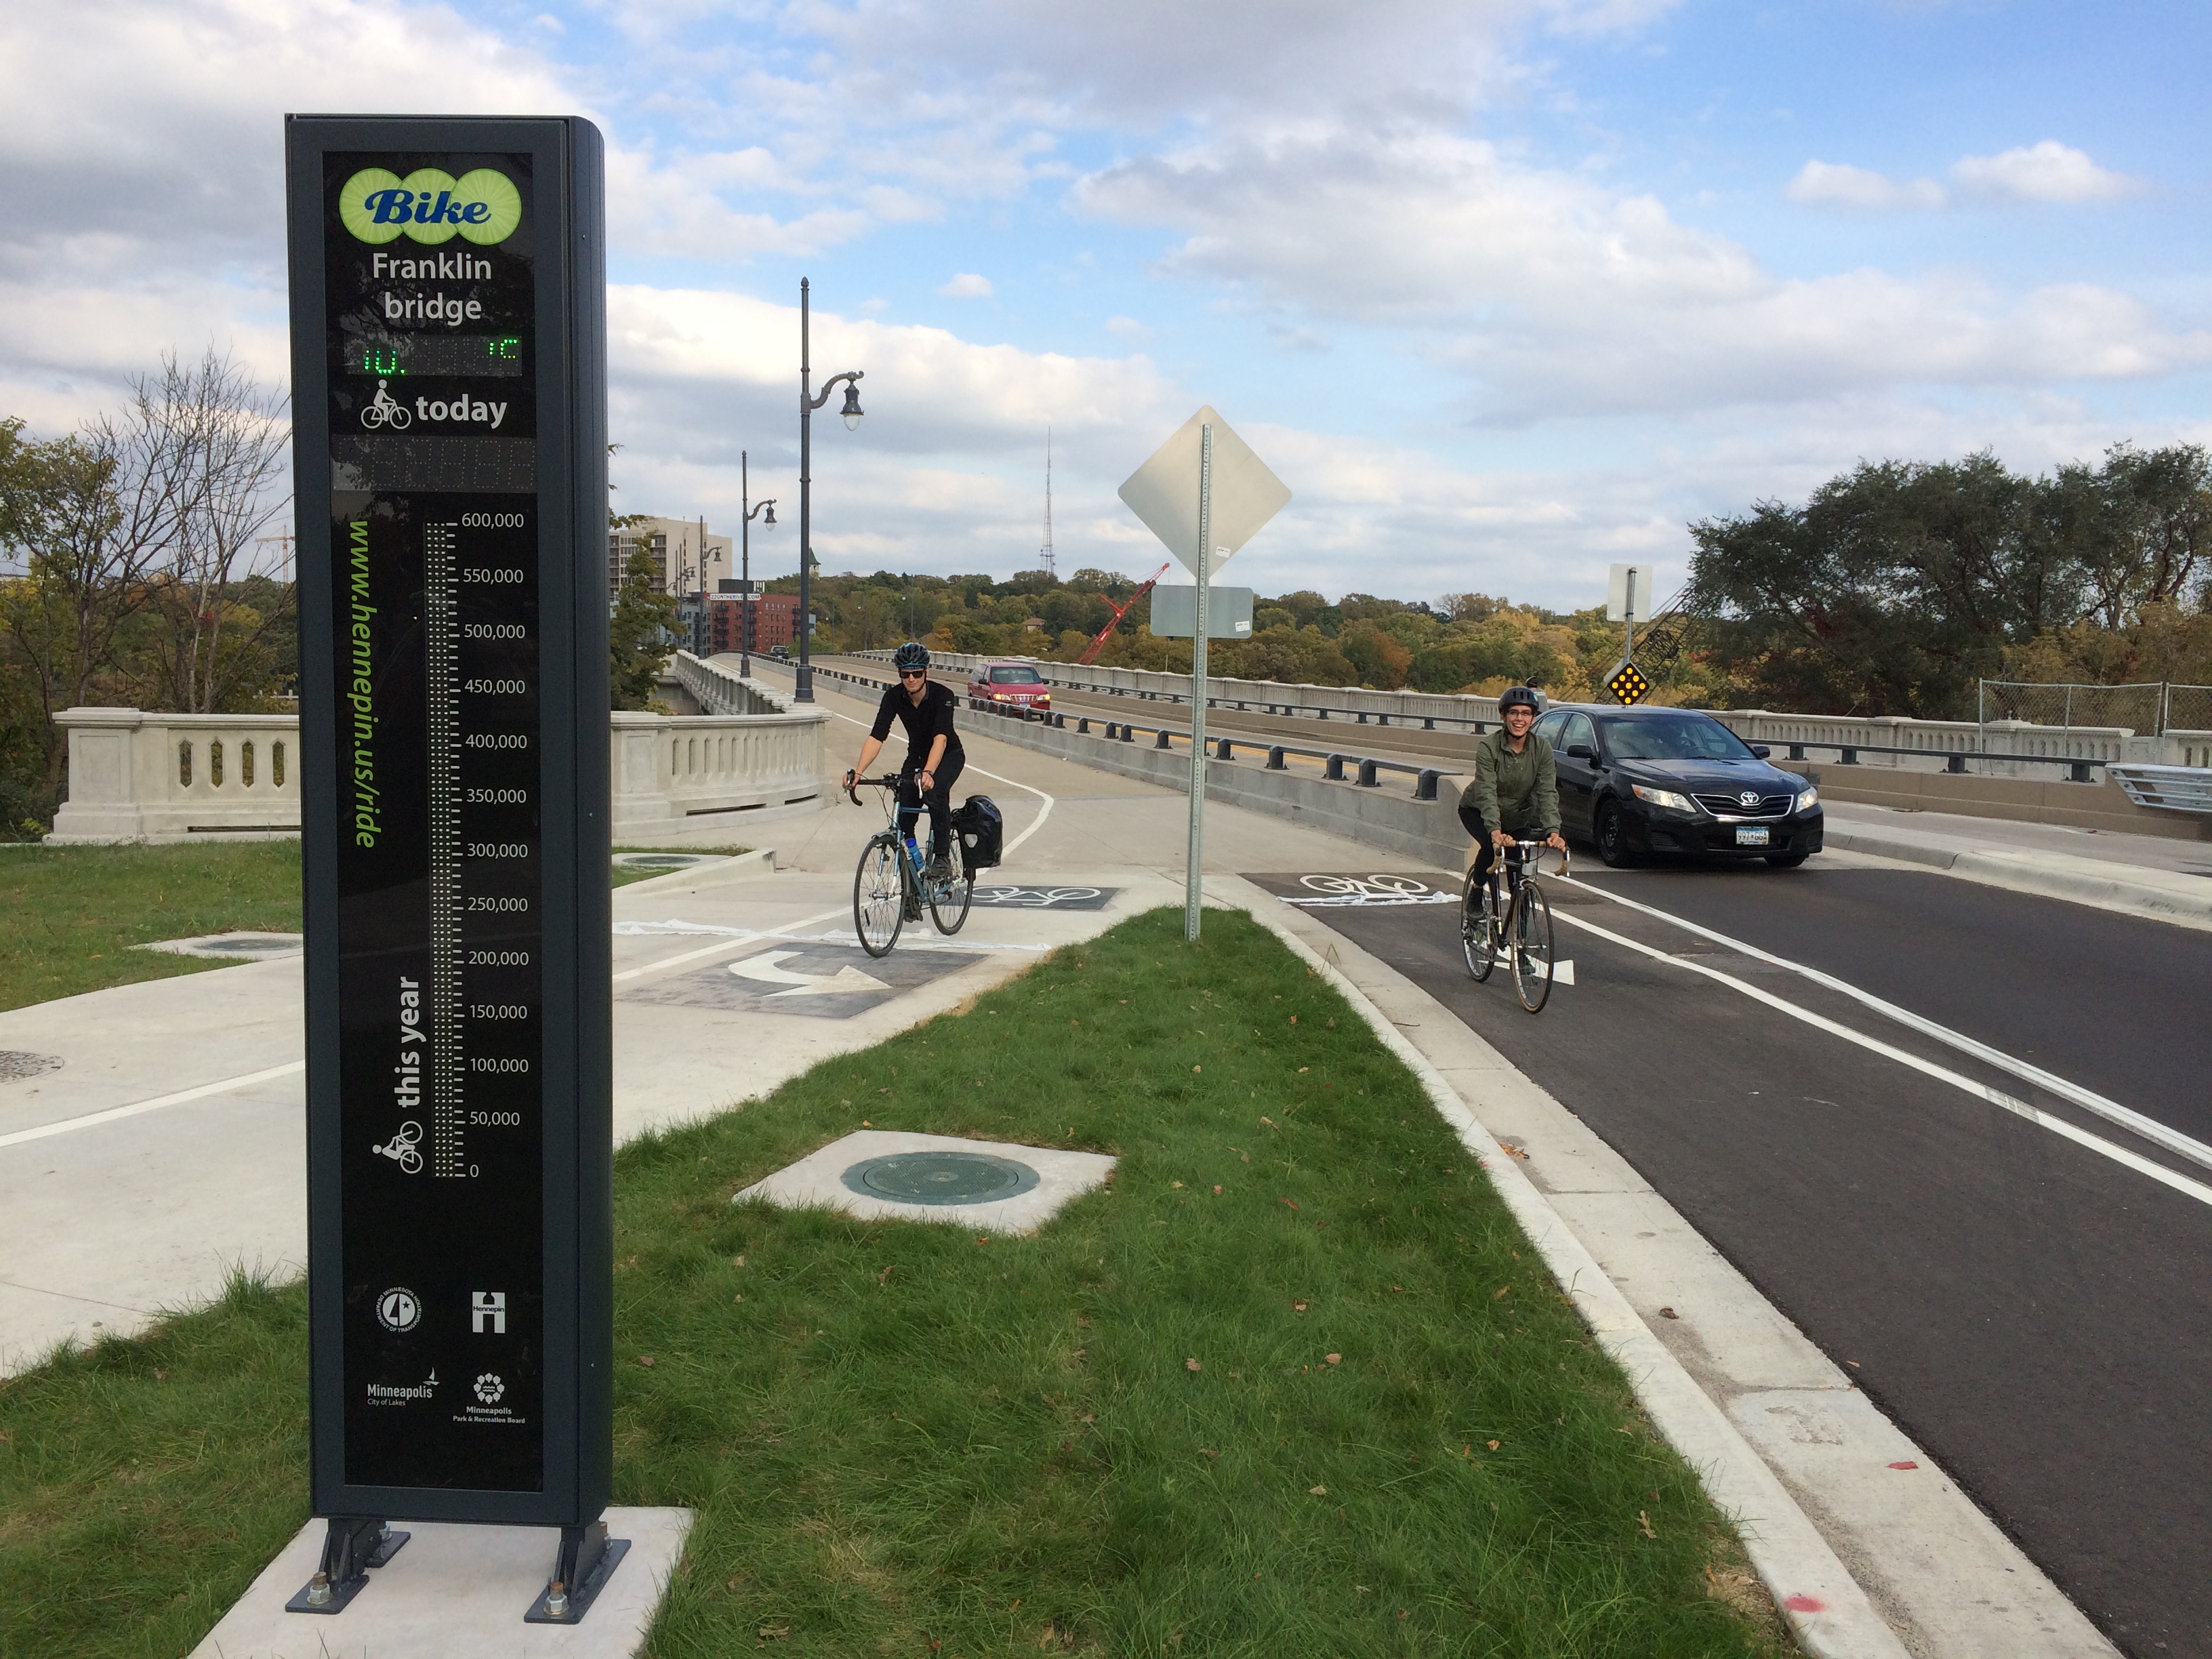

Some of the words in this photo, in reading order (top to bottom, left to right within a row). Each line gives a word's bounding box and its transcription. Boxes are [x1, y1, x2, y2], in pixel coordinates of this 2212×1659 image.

[365, 189, 491, 224] Bike
[373, 253, 491, 279] Franklin
[385, 292, 482, 326] bridge
[415, 394, 508, 429] today
[462, 513, 524, 529] 600,000
[463, 569, 524, 584] 550,000
[464, 624, 526, 640] 500,000
[346, 520, 382, 848] www.hennepin.us/ride
[464, 680, 525, 695] 450,000
[465, 735, 527, 750] 400,000
[466, 789, 527, 804] 350,000
[467, 844, 528, 859] 300,000
[468, 897, 528, 913] 250,000
[468, 951, 529, 966] 200,000
[400, 977, 427, 1043] year
[470, 1005, 527, 1020] 150,000
[470, 1059, 529, 1073] 100,000
[394, 1052, 420, 1107] this
[470, 1111, 520, 1126] 50,000
[470, 1164, 479, 1178] 0
[383, 1286, 415, 1297] MINNESOTA
[375, 1294, 390, 1329] DEPARTMENT
[397, 1295, 422, 1333] TRANSPORTATION
[473, 1305, 505, 1313] Hennepin
[367, 1383, 433, 1401] Minneapolis
[367, 1398, 380, 1406] City
[466, 1406, 512, 1415] Minneapolis
